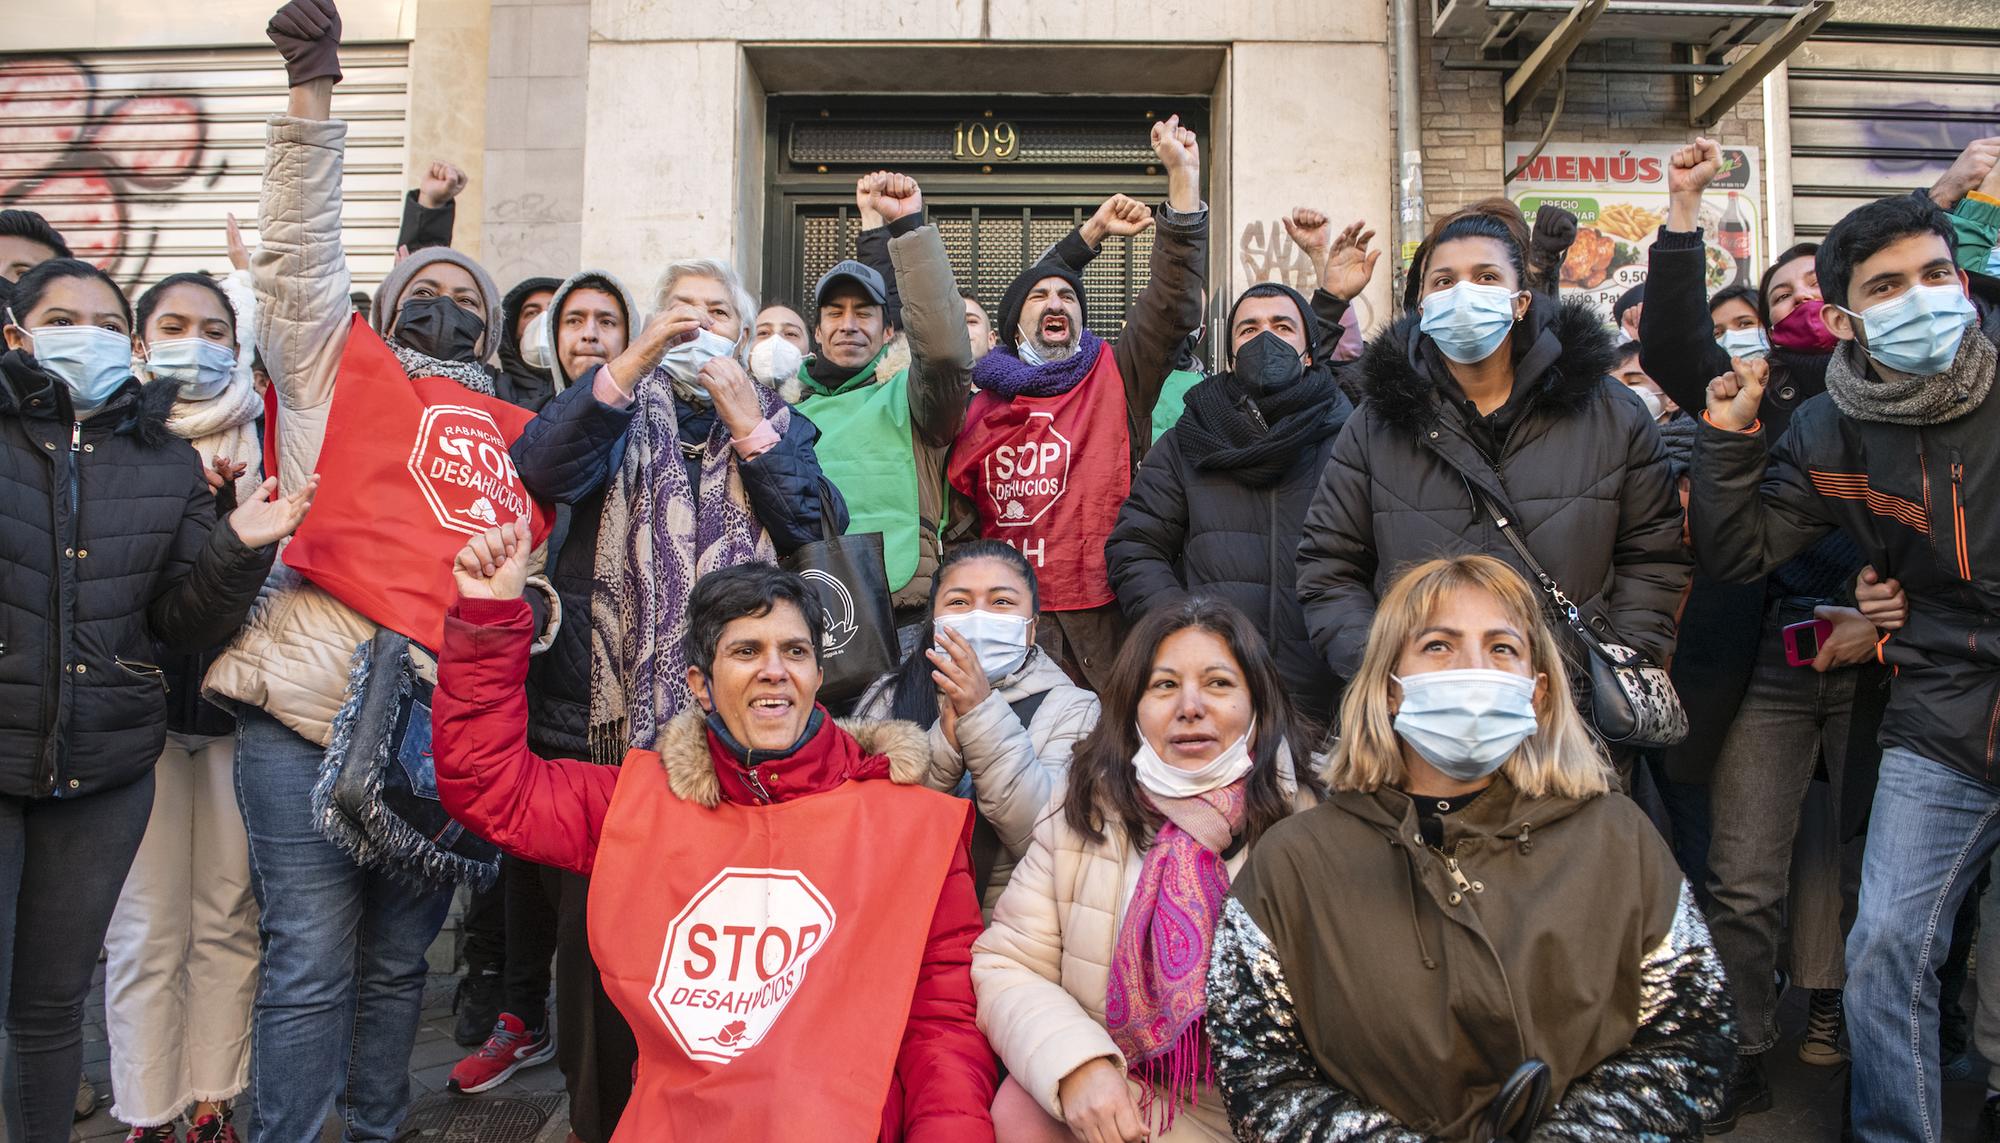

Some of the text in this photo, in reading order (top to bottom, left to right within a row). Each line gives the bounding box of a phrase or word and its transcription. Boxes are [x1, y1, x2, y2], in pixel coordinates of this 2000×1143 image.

[955, 121, 1015, 156] 109
[1515, 150, 1664, 183] MENÚS
[1523, 211, 1596, 220] PA VAR
[430, 456, 524, 518] DESAHUCIOS
[684, 923, 822, 982] STOP
